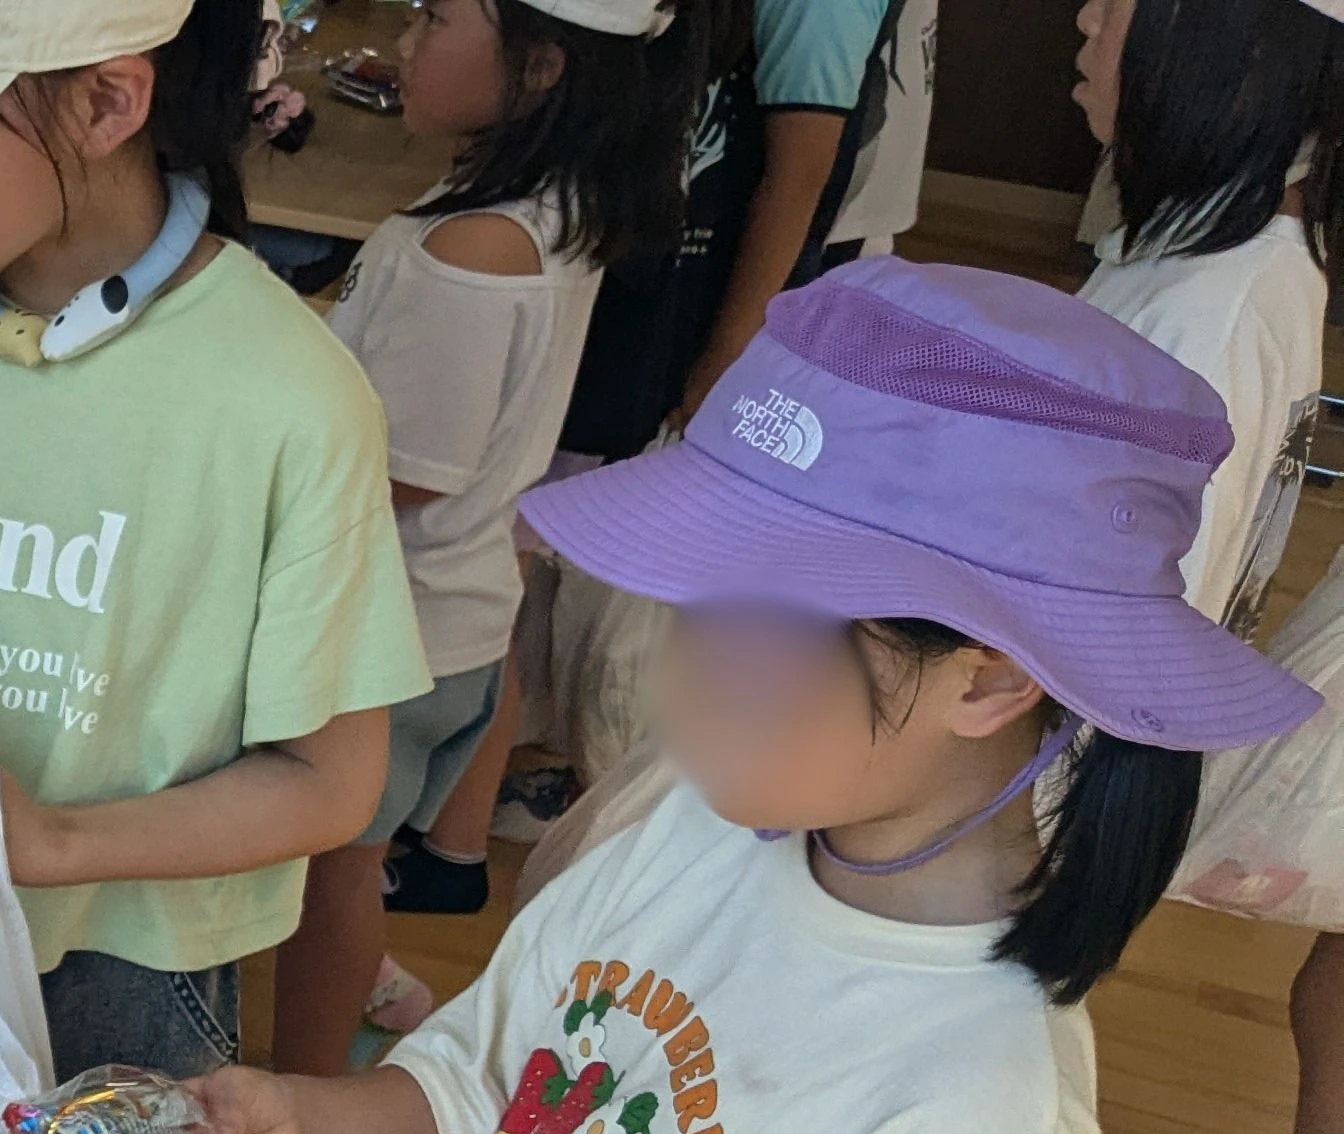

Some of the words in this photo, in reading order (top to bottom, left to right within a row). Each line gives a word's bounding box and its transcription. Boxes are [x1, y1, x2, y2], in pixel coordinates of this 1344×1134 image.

[732, 394, 790, 437] NORTH
[765, 388, 800, 420] THE
[732, 420, 780, 453] FACE
